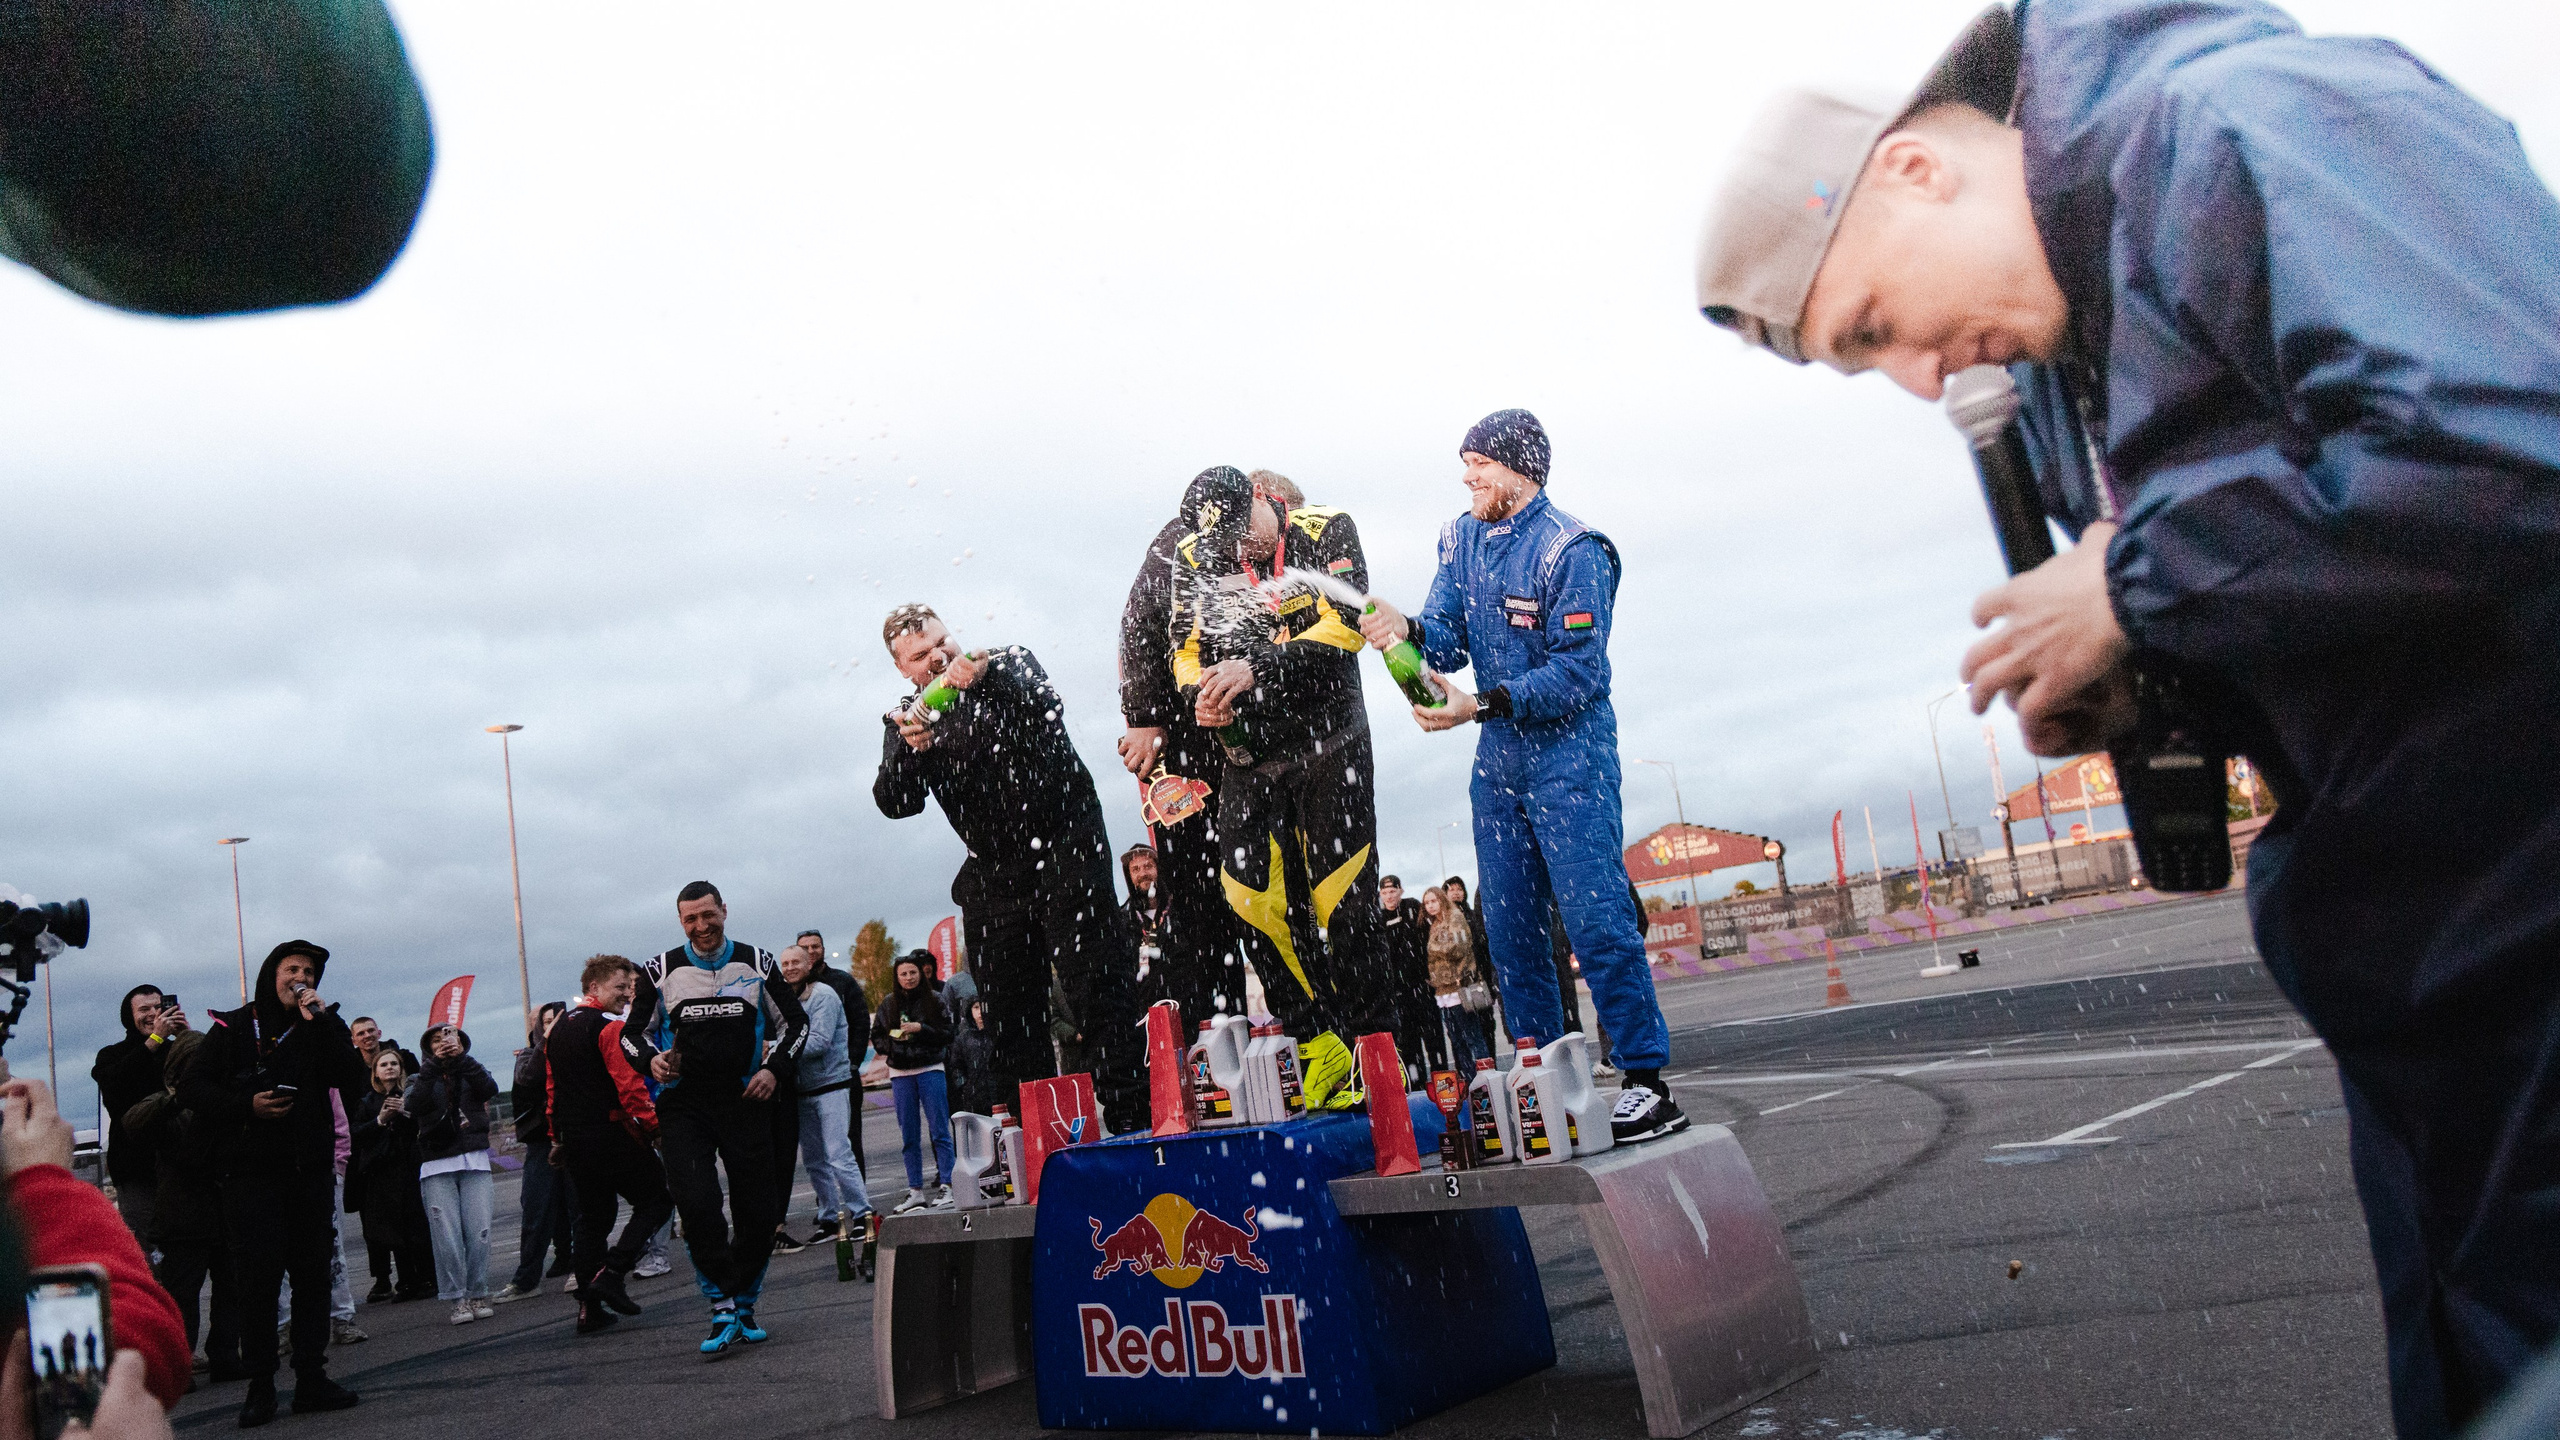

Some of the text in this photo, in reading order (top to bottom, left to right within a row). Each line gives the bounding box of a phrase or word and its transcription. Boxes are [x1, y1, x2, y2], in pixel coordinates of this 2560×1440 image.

[1306, 521, 1322, 530] OMP
[1545, 533, 1571, 564] sparco
[1986, 889, 2018, 905] GSM
[1704, 902, 1770, 919] АВТОСАЛОН
[1705, 907, 1812, 931] ЭЛЕКТРОМОБИЛЕЙ
[1707, 936, 1737, 950] GSM
[680, 1002, 744, 1018] ASTARS
[1155, 1147, 1166, 1166] 1
[1446, 1176, 1460, 1197] 3
[962, 1213, 972, 1232] 2
[1078, 1294, 1306, 1379] Red Bull
